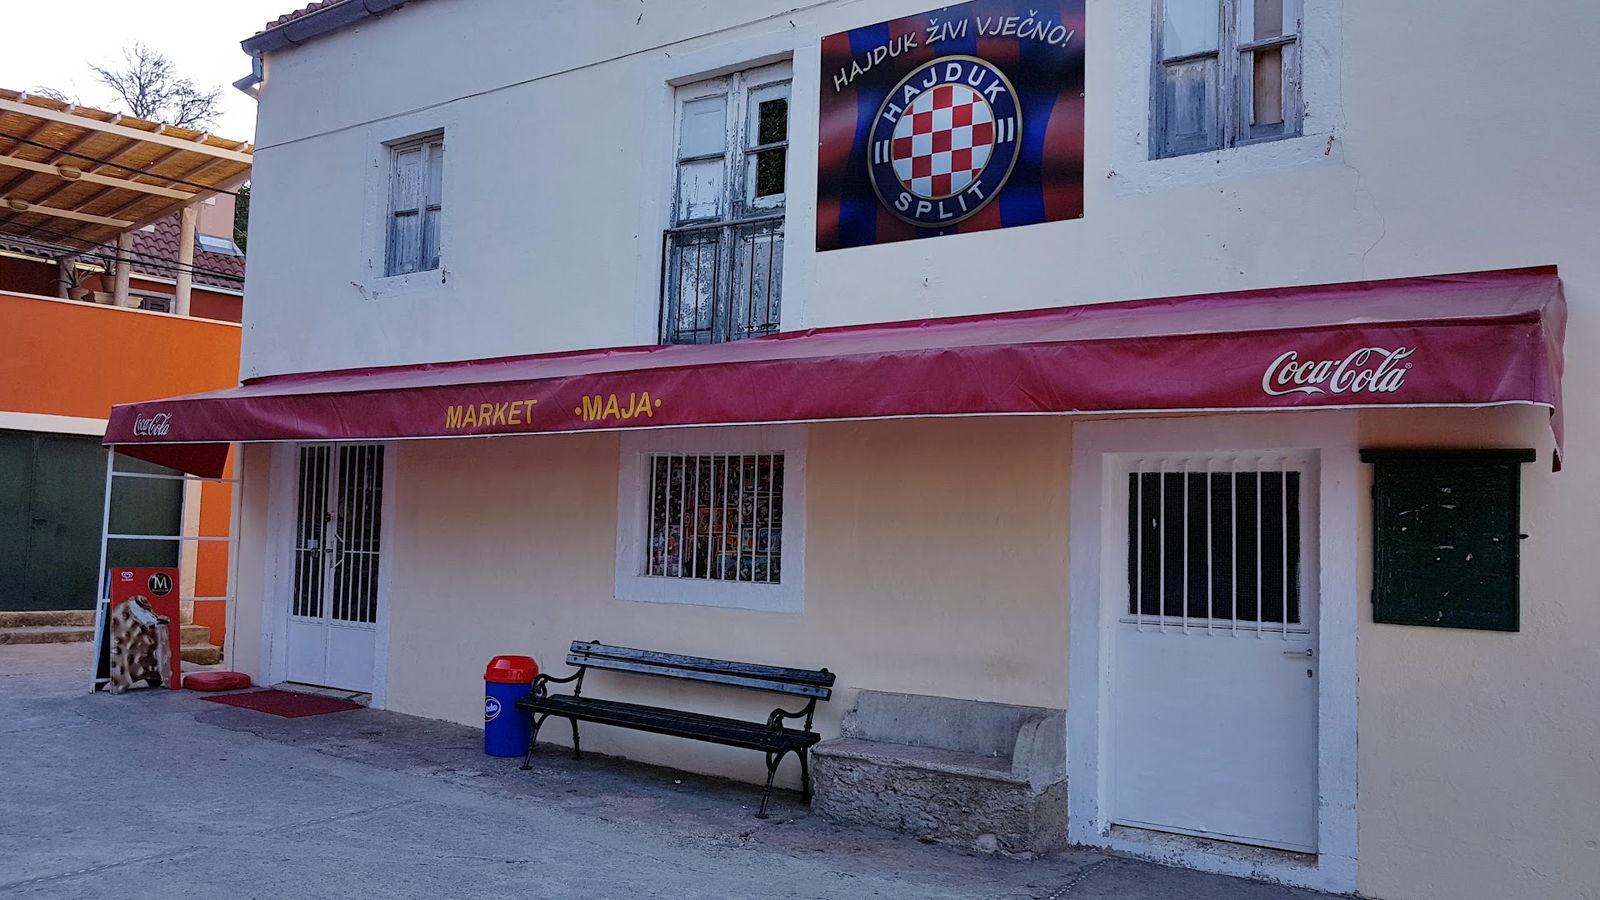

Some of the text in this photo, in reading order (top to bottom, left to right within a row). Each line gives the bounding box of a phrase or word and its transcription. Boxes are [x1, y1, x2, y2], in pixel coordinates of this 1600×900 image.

[833, 9, 1074, 92] HAJDUK ŽIVI VJEČNO!
[883, 63, 1006, 123] HAJDUK
[895, 180, 985, 219] SPLIT
[1262, 346, 1416, 396] Coca-Cola
[445, 399, 538, 429] MARKET
